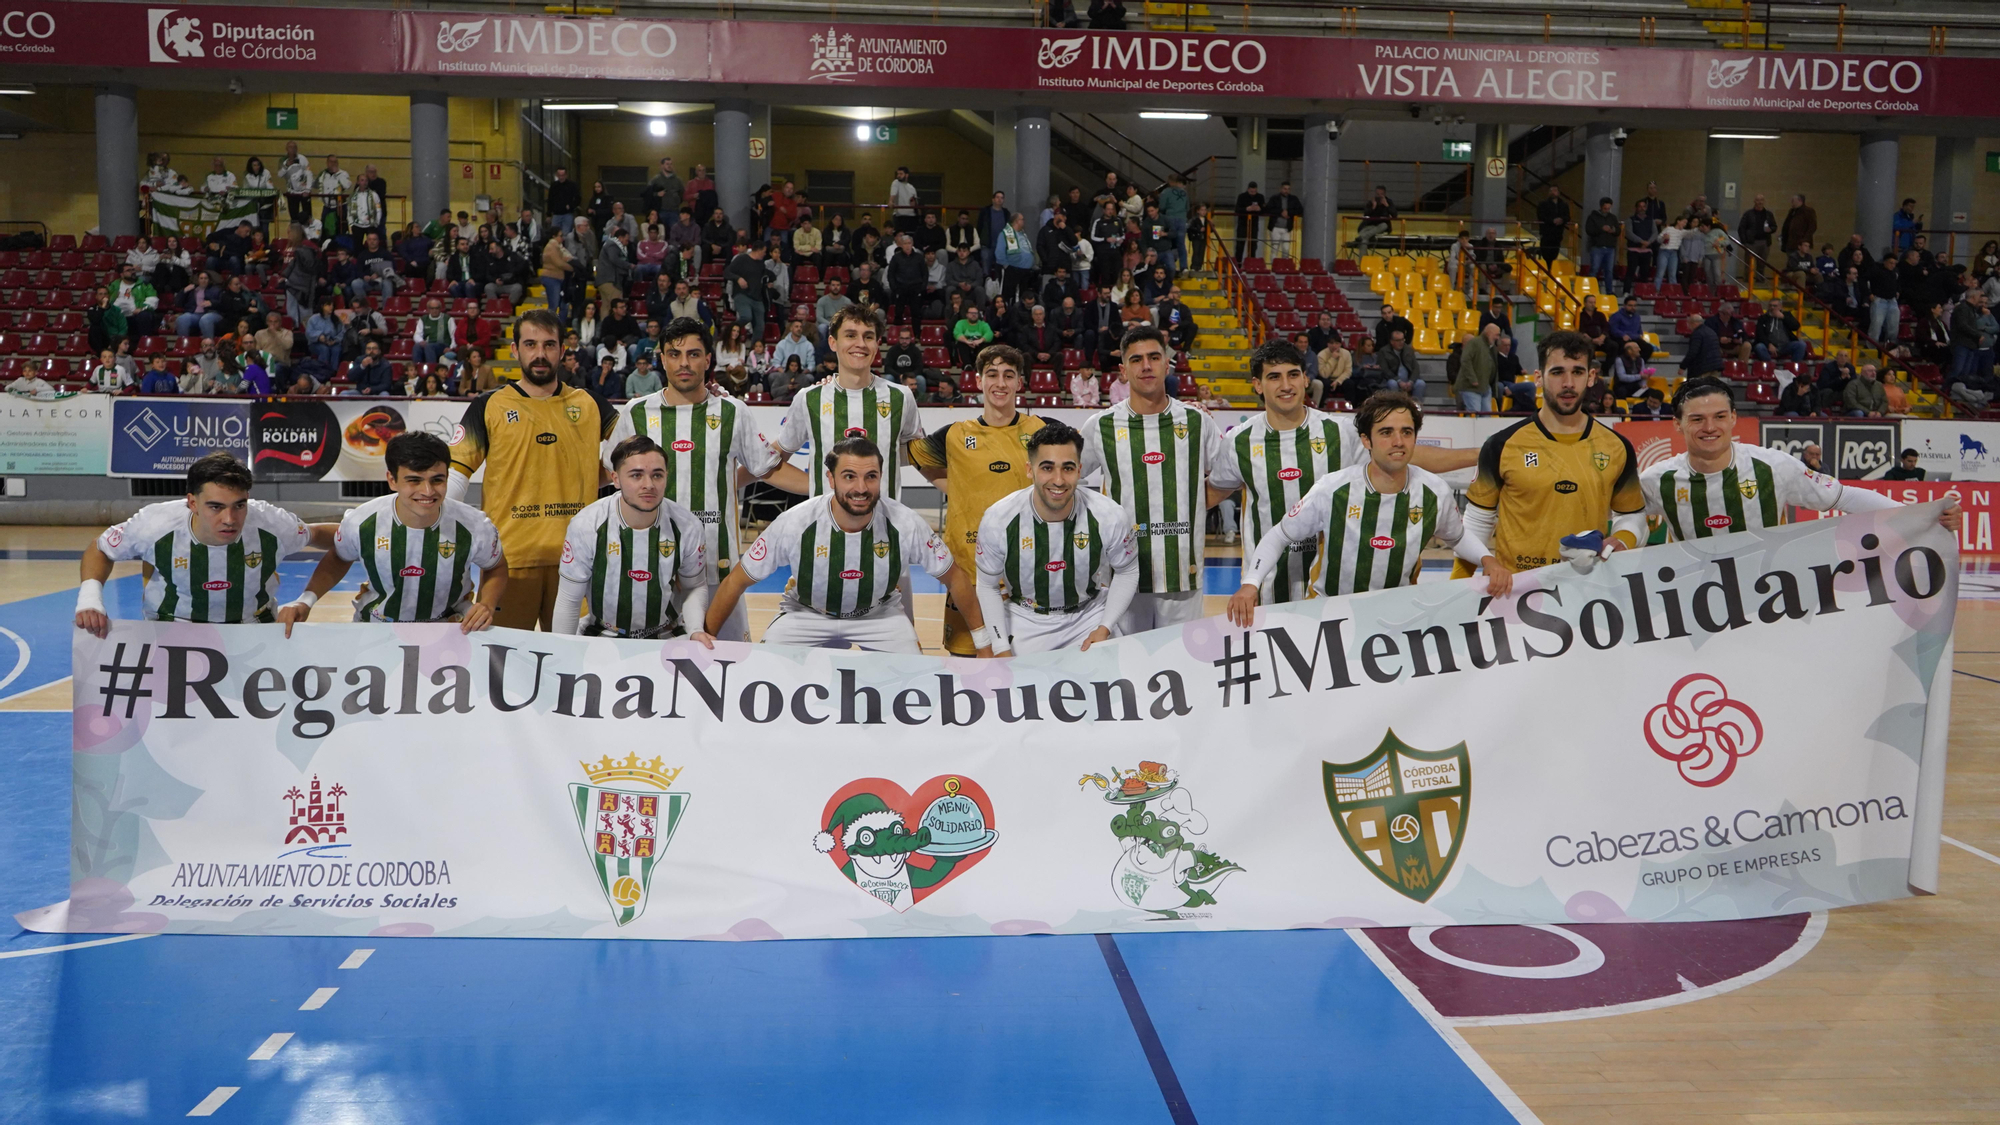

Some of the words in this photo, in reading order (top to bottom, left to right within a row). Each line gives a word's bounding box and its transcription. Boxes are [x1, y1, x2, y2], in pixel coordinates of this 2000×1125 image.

[212, 22, 314, 42] Diputación
[493, 19, 677, 58] IMDECO
[15, 43, 55, 53] Córdoba
[213, 42, 236, 58] de
[241, 43, 317, 60] Córdoba
[858, 38, 947, 55] AYUNTAMIENTO
[1091, 36, 1267, 74] IMDECO
[1375, 45, 1439, 60] PALACIO
[1443, 48, 1523, 63] MUNICIPAL
[1528, 51, 1599, 65] DEPORTES
[438, 60, 487, 72] Instituto
[490, 61, 548, 75] Municipal
[551, 63, 566, 74] de
[858, 57, 873, 72] DE
[876, 55, 934, 74] CÓRDOBA
[1357, 64, 1462, 97] VISTA
[1474, 68, 1619, 101] ALEGRE
[1757, 57, 1922, 94] IMDECO
[1038, 76, 1085, 88] Instituto
[1087, 77, 1142, 90] Municipal
[1145, 79, 1160, 90] de
[1162, 80, 1214, 93] Deportes
[1216, 80, 1265, 93] Córdoba
[1706, 96, 1750, 107] Instituto
[1752, 97, 1805, 110] Municipal
[1807, 98, 1821, 109] de
[1823, 99, 1872, 112] Deportes
[1874, 99, 1919, 111] Córdoba
[276, 112, 287, 126] F
[876, 125, 890, 141] G
[1450, 142, 1464, 158] H
[0, 408, 103, 419] LATECOR
[173, 437, 250, 448] TECNOLÓGIC
[1841, 441, 1888, 470] RG3
[153, 463, 185, 471] PROCESOS
[99, 643, 1193, 739] #RegalaUnaNochebuena
[1213, 532, 1946, 708] #MenúSolidario
[1403, 763, 1456, 779] CÓRDOBA
[1411, 775, 1453, 789] FUTSAL
[171, 863, 325, 888] AYUNTAMIENTO
[327, 864, 352, 887] DE
[356, 860, 452, 887] CORDOBA
[1641, 867, 1703, 887] GRUPO
[1707, 864, 1730, 878] DE
[1734, 848, 1822, 874] EMPRESAS
[148, 894, 253, 909] Delegación
[259, 896, 284, 908] de
[289, 894, 374, 909] Servicios
[380, 893, 458, 909] Sociales
